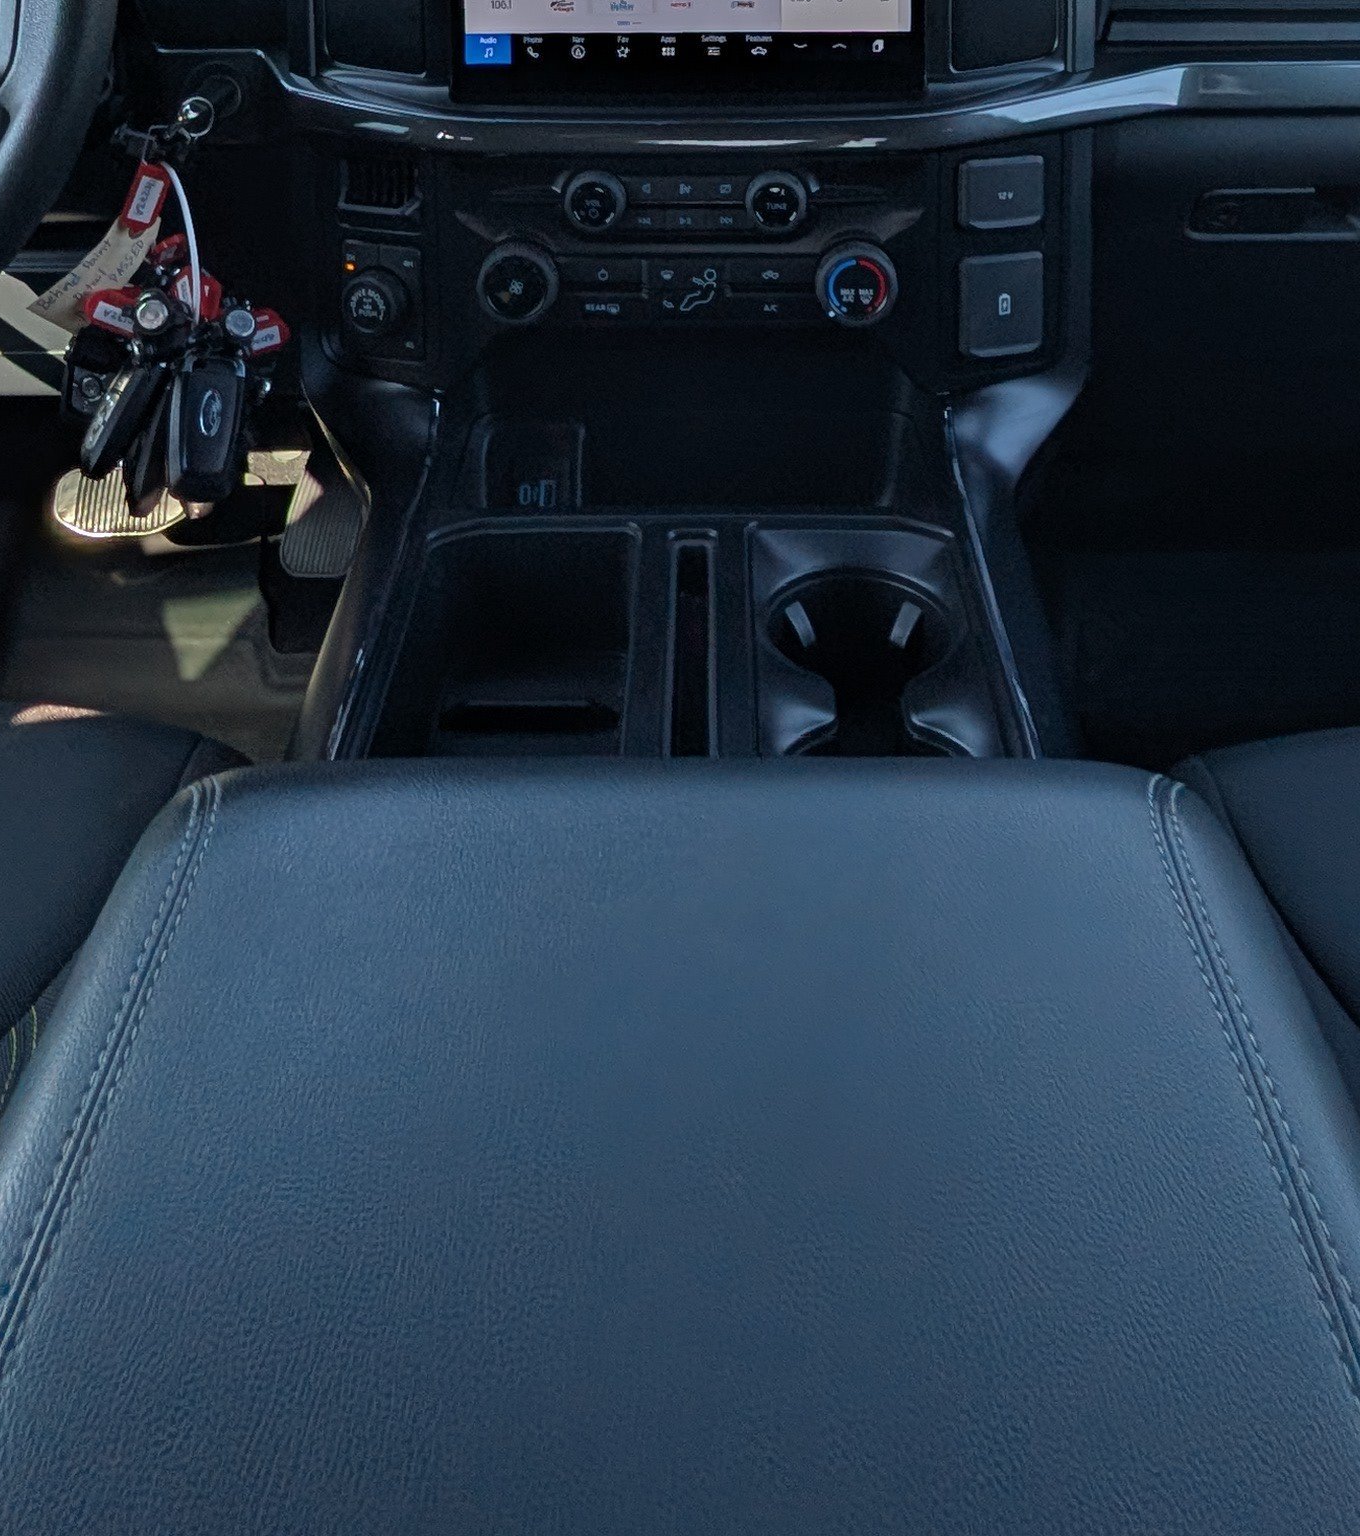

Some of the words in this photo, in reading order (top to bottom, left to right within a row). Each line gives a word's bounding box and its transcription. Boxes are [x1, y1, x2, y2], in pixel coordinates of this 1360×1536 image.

[490, 0, 513, 10] 106.1
[479, 36, 498, 45] Audio
[660, 35, 677, 45] Apps
[585, 303, 607, 313] REAR
